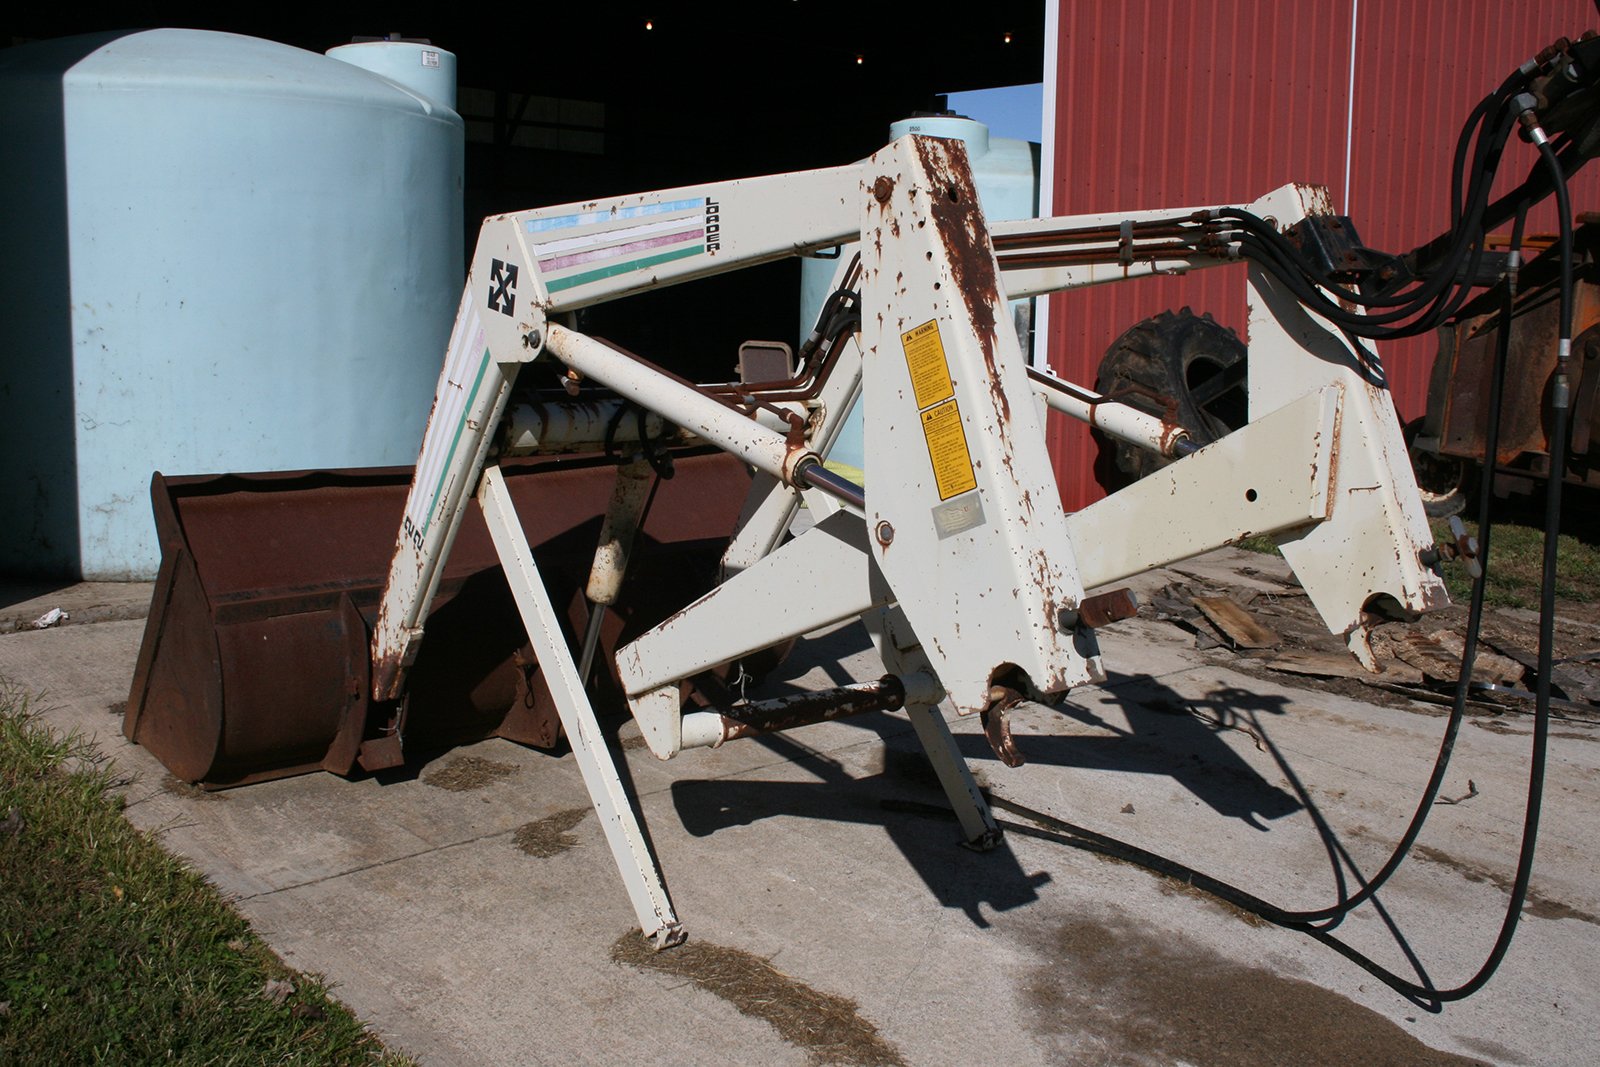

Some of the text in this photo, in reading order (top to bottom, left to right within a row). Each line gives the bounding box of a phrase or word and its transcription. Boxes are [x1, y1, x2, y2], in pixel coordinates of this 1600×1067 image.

[706, 197, 720, 252] LOADER
[915, 324, 933, 337] WARNING
[934, 404, 954, 417] CAUTION
